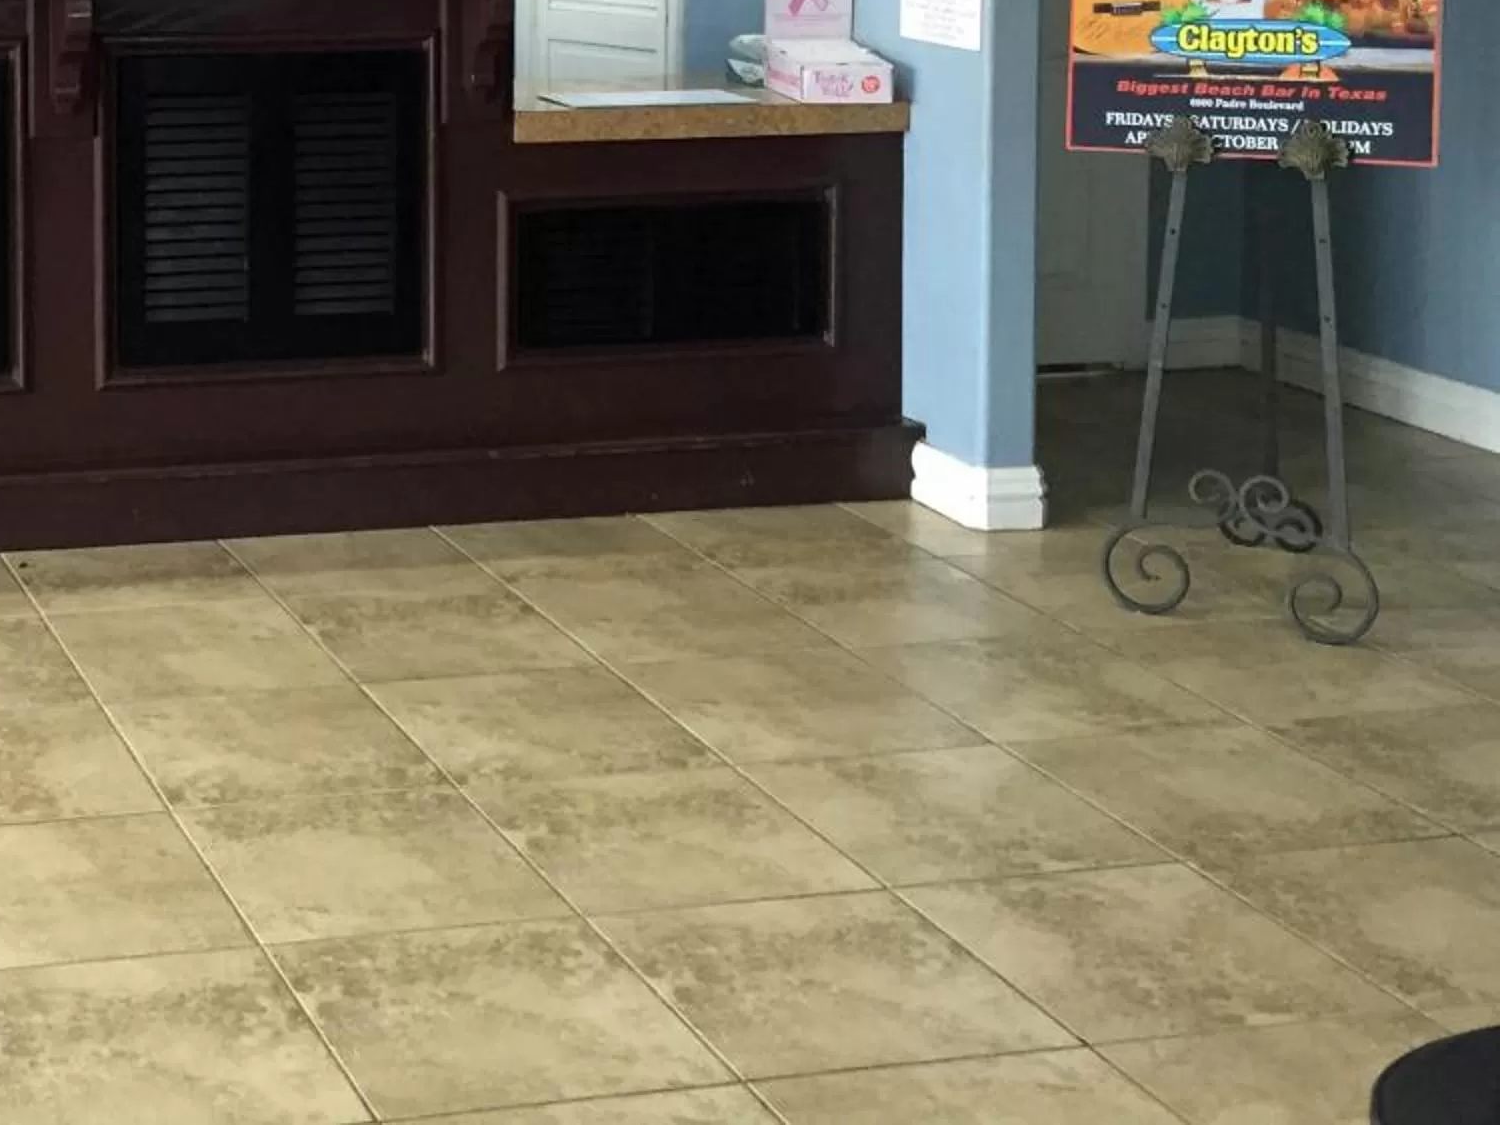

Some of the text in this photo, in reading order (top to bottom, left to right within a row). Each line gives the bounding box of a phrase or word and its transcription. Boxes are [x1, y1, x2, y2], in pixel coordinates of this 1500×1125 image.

[1178, 24, 1318, 58] Clayton's
[1115, 79, 1188, 97] Biggest
[1193, 81, 1255, 97] Beach
[1261, 83, 1296, 98] Bar
[1328, 85, 1388, 102] Texas
[1215, 97, 1247, 109] Padre
[1249, 98, 1304, 112] Boulevard
[1105, 111, 1174, 129] FRIDAYS
[1318, 119, 1394, 136] OLIDAYS
[1211, 133, 1279, 151] CTOBER
